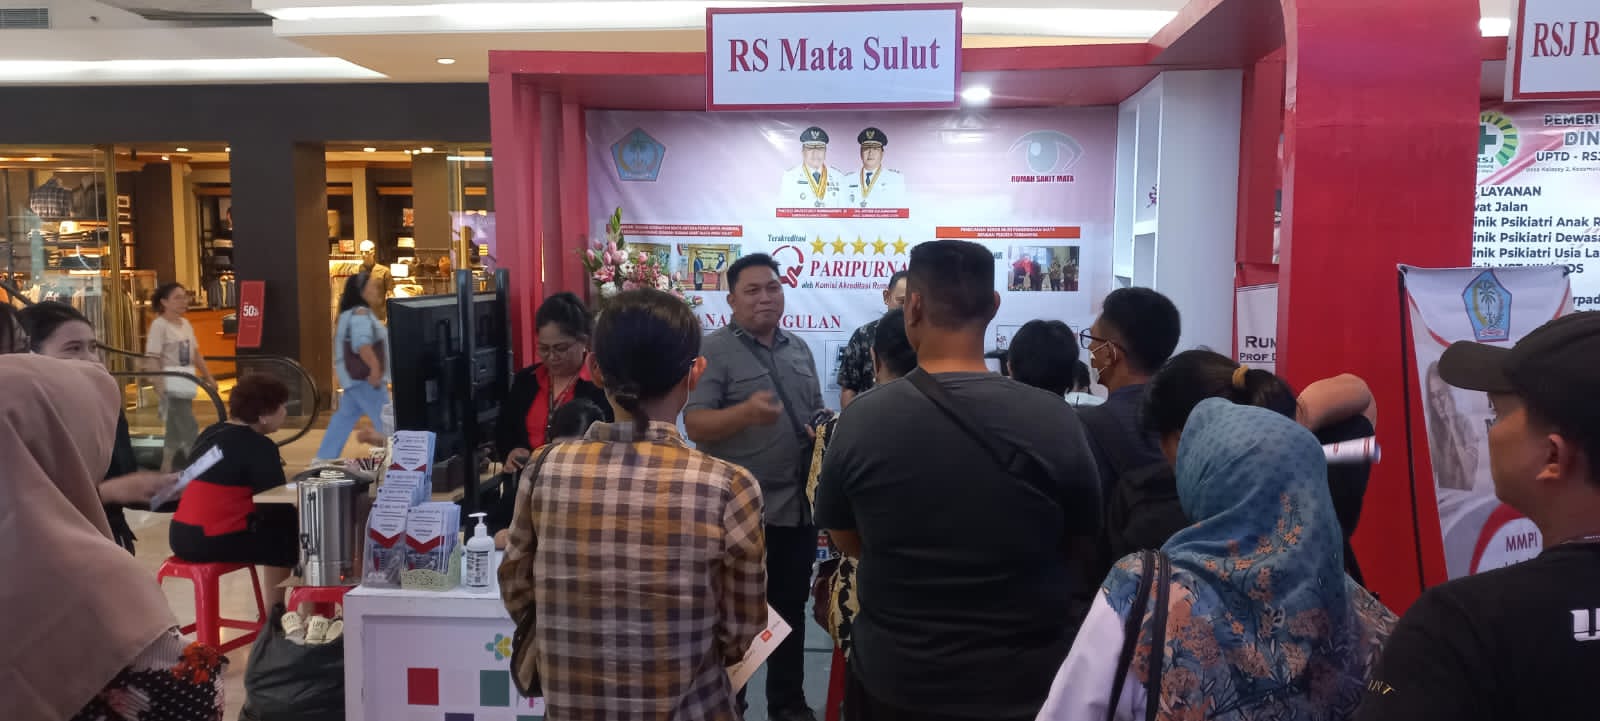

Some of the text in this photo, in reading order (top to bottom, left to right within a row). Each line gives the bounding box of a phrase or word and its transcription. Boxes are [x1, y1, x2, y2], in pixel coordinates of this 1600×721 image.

[1531, 21, 1579, 57] RSJ
[728, 36, 941, 72] RS Mata Sulut
[1544, 114, 1599, 125] PEMERI
[1565, 131, 1600, 146] DIN
[1536, 151, 1570, 162] UPTD
[1480, 186, 1541, 197] LAYANAN
[1495, 201, 1528, 212] Jalan
[1501, 216, 1552, 227] Psikiatri
[1556, 216, 1589, 227] Anak
[1500, 231, 1552, 243] Psikiatri
[1555, 232, 1600, 243] Dewas
[1499, 247, 1550, 258] Psikiatri
[1555, 247, 1581, 258] Usia
[778, 314, 841, 329] GULAN
[1240, 352, 1269, 361] PROF
[1505, 532, 1538, 552] MMPI
